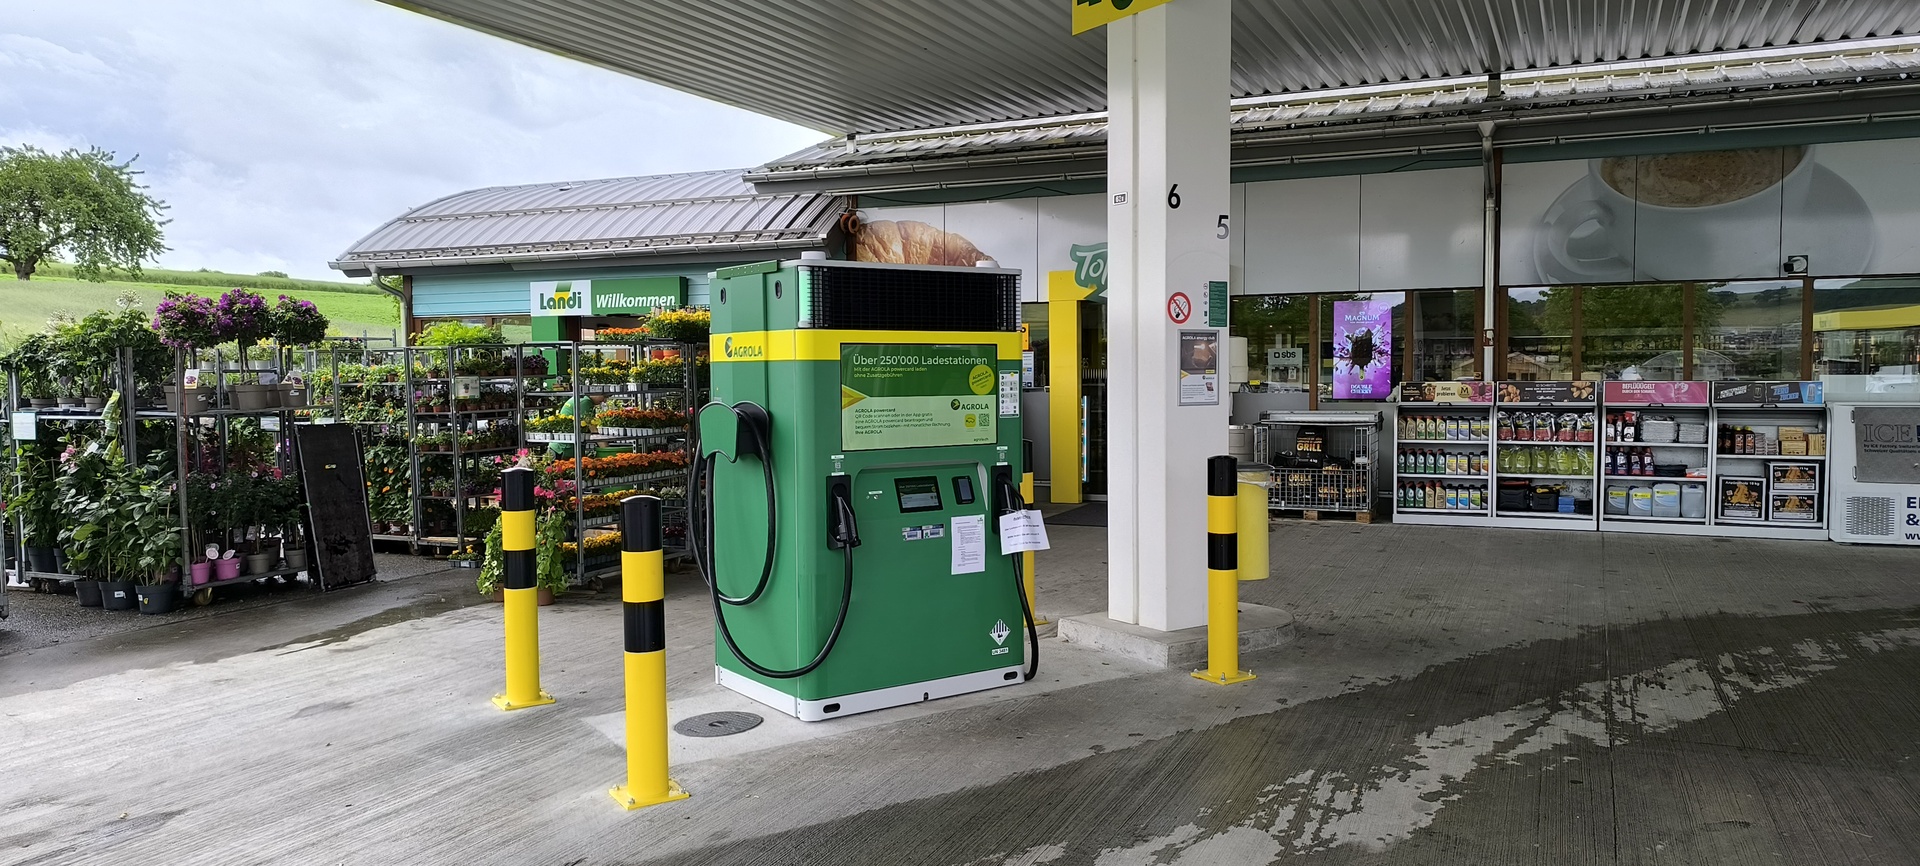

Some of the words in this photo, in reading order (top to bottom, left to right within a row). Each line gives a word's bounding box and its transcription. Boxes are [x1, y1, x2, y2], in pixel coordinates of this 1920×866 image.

[1168, 184, 1180, 209] 6
[1217, 215, 1229, 239] 5
[540, 292, 581, 310] Landi
[596, 293, 675, 308] Willkommen
[733, 346, 763, 357] AGROLA
[1281, 350, 1296, 359] sbs
[853, 354, 877, 365] Über
[880, 356, 919, 365] 250'000
[922, 355, 987, 365] Ladestationen
[1863, 424, 1913, 443] ICE
[1297, 443, 1321, 452] GRILL
[1907, 496, 1920, 509] E
[1906, 513, 1920, 526] &
